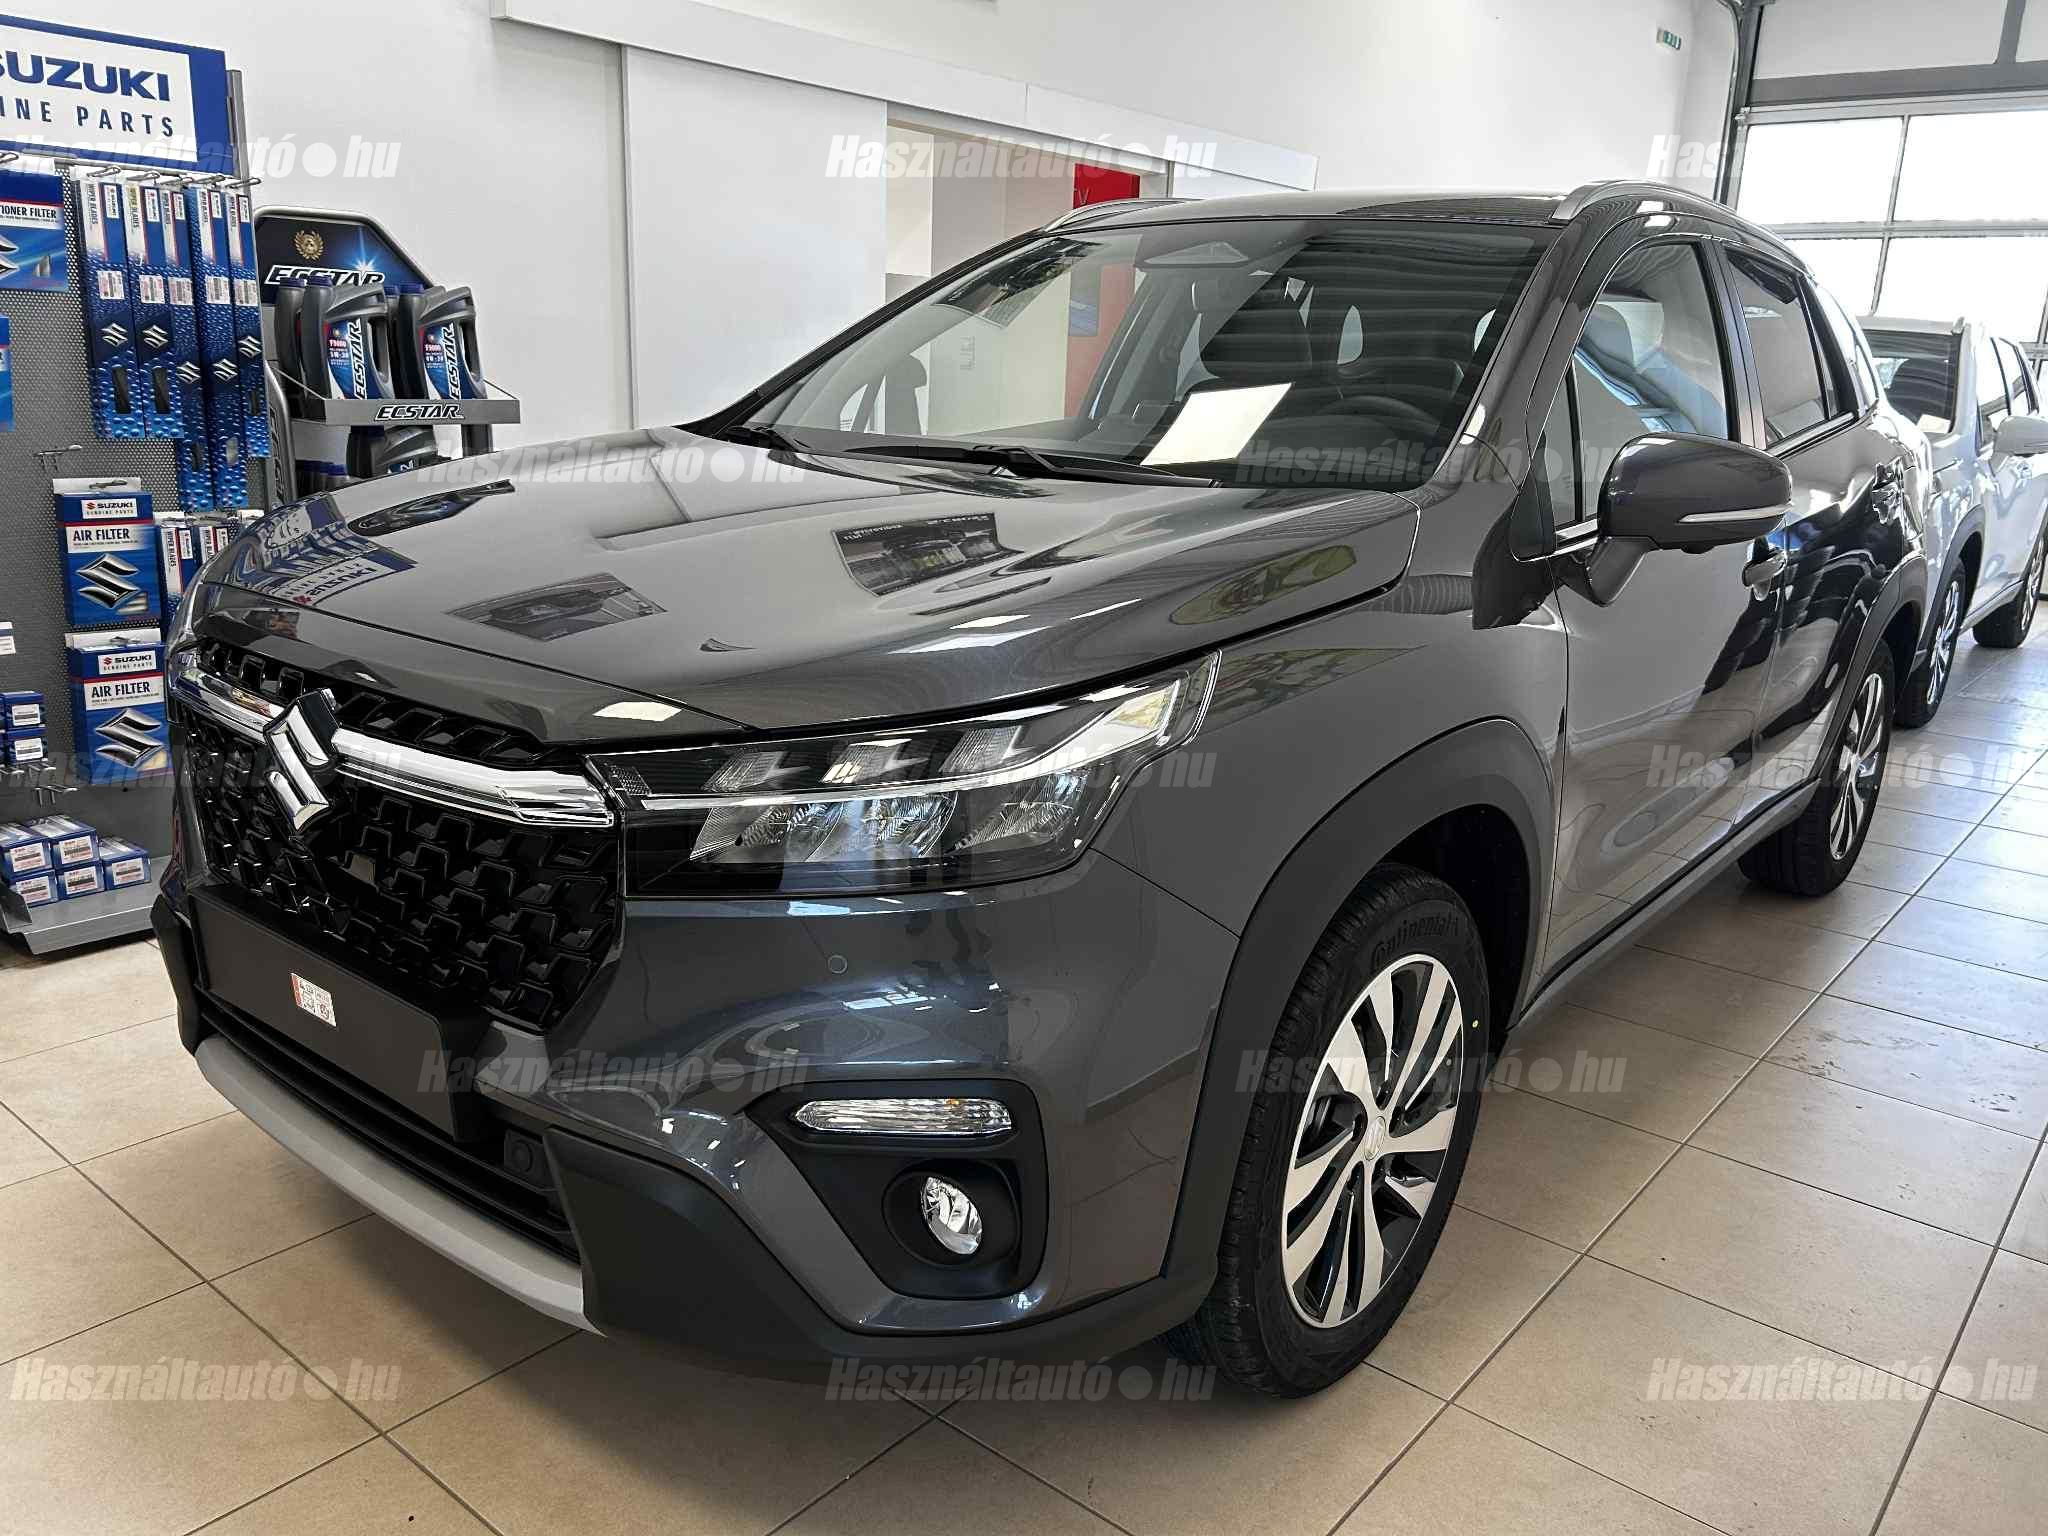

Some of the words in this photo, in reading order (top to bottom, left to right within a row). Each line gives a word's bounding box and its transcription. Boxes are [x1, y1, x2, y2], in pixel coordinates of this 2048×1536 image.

[0, 50, 170, 102] UZUKI
[77, 105, 174, 137] PARTS
[0, 204, 28, 216] IONER
[30, 207, 57, 219] FILTER
[347, 317, 368, 400] ECSTAR
[440, 321, 462, 400] ECSTAR
[374, 403, 465, 421] ECSTAR
[73, 529, 92, 542] AIR
[95, 528, 130, 541] FILTER
[114, 654, 152, 664] SUZUKI
[91, 685, 112, 698] AIR
[115, 681, 151, 696] FILTER
